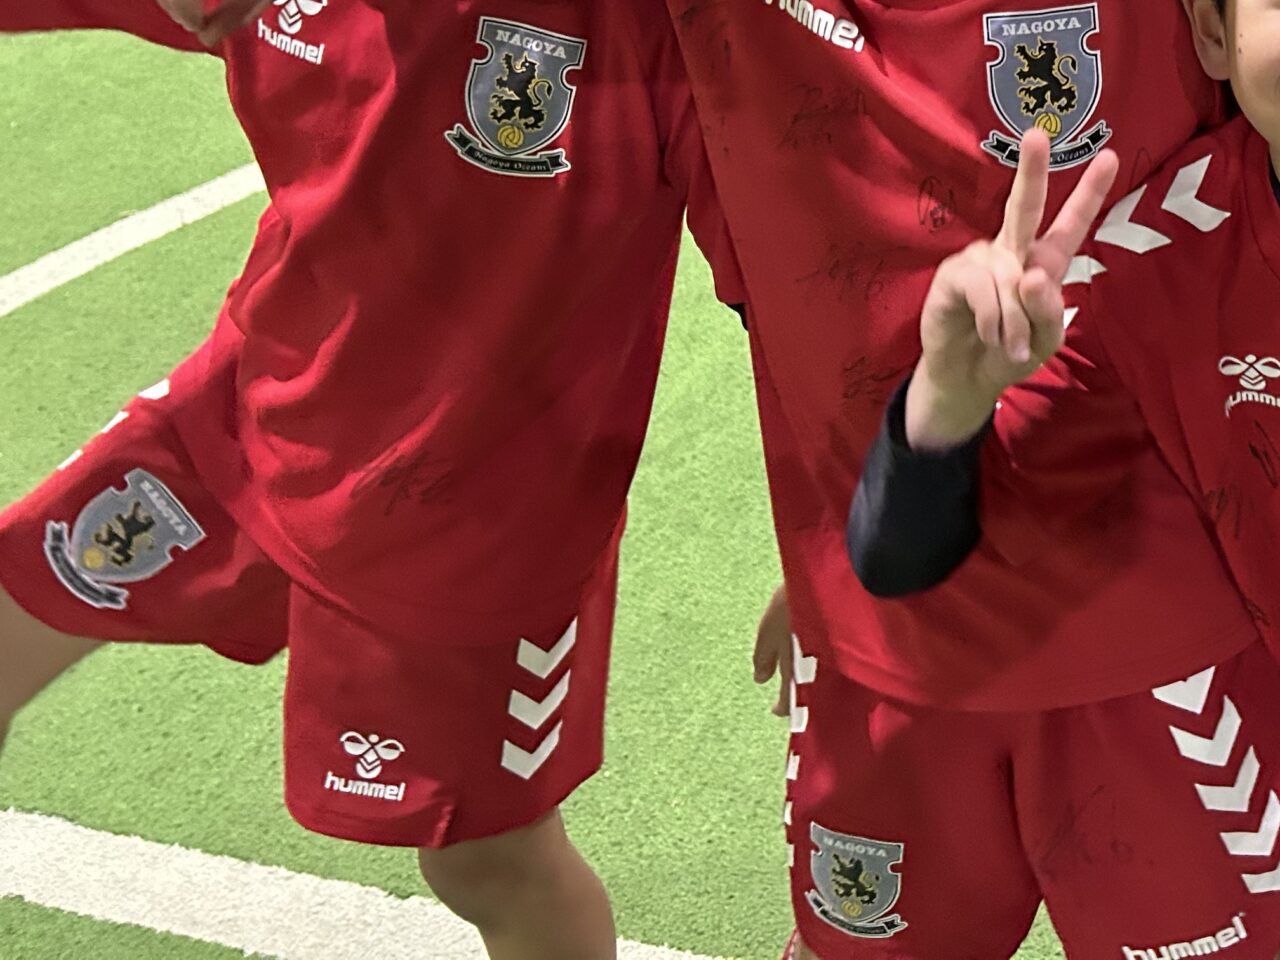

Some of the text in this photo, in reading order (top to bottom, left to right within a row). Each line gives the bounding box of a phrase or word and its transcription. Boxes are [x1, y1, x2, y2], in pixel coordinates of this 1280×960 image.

[1002, 15, 1082, 37] NAGOYA
[257, 18, 325, 66] hummel
[496, 29, 567, 59] NAGOYA
[140, 480, 188, 536] NAGOYA
[325, 771, 405, 802] hummel
[822, 835, 888, 858] NAGOYA
[1122, 915, 1247, 960] hummel
